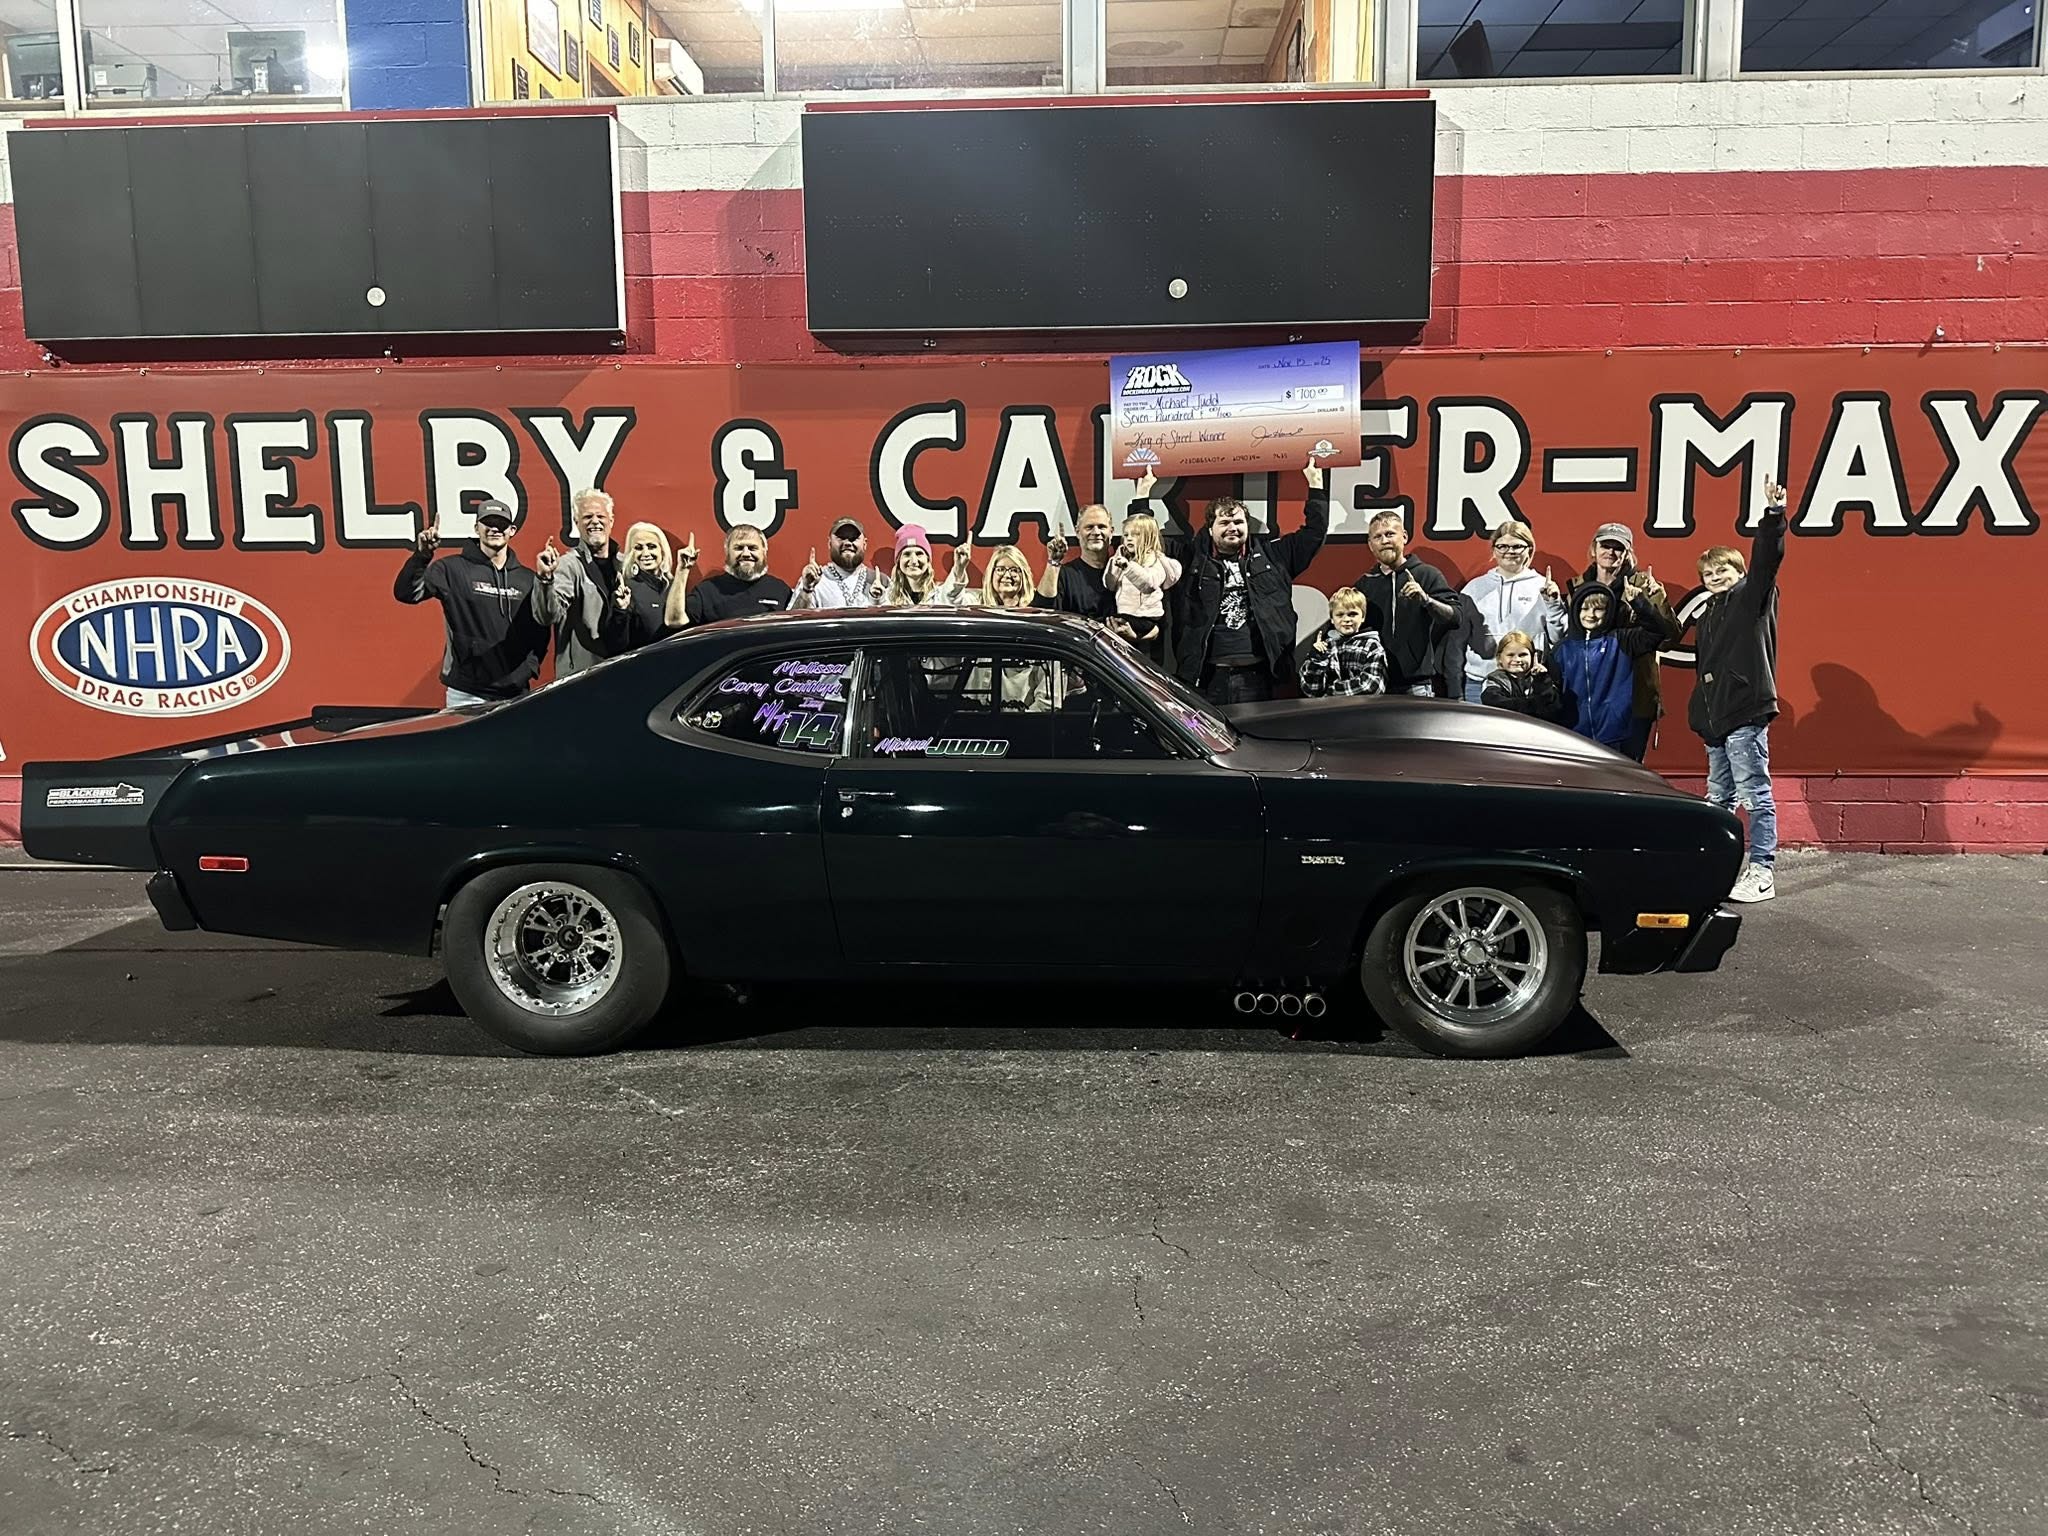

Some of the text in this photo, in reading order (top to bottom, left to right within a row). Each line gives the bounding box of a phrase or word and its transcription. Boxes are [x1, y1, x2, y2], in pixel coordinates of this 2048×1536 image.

[1149, 392, 1219, 413] Michael Judd
[10, 406, 636, 553] SHELBY
[711, 419, 798, 540] &
[71, 583, 238, 614] CHAMPIONSHIP
[79, 606, 248, 682] NHRA
[772, 660, 847, 676] Melissa
[81, 678, 241, 709] DRAG RACING
[718, 677, 770, 698] Cory
[778, 710, 843, 750] 14
[873, 736, 1010, 757] Michael JUDD
[58, 788, 117, 798] BLACKBIRD
